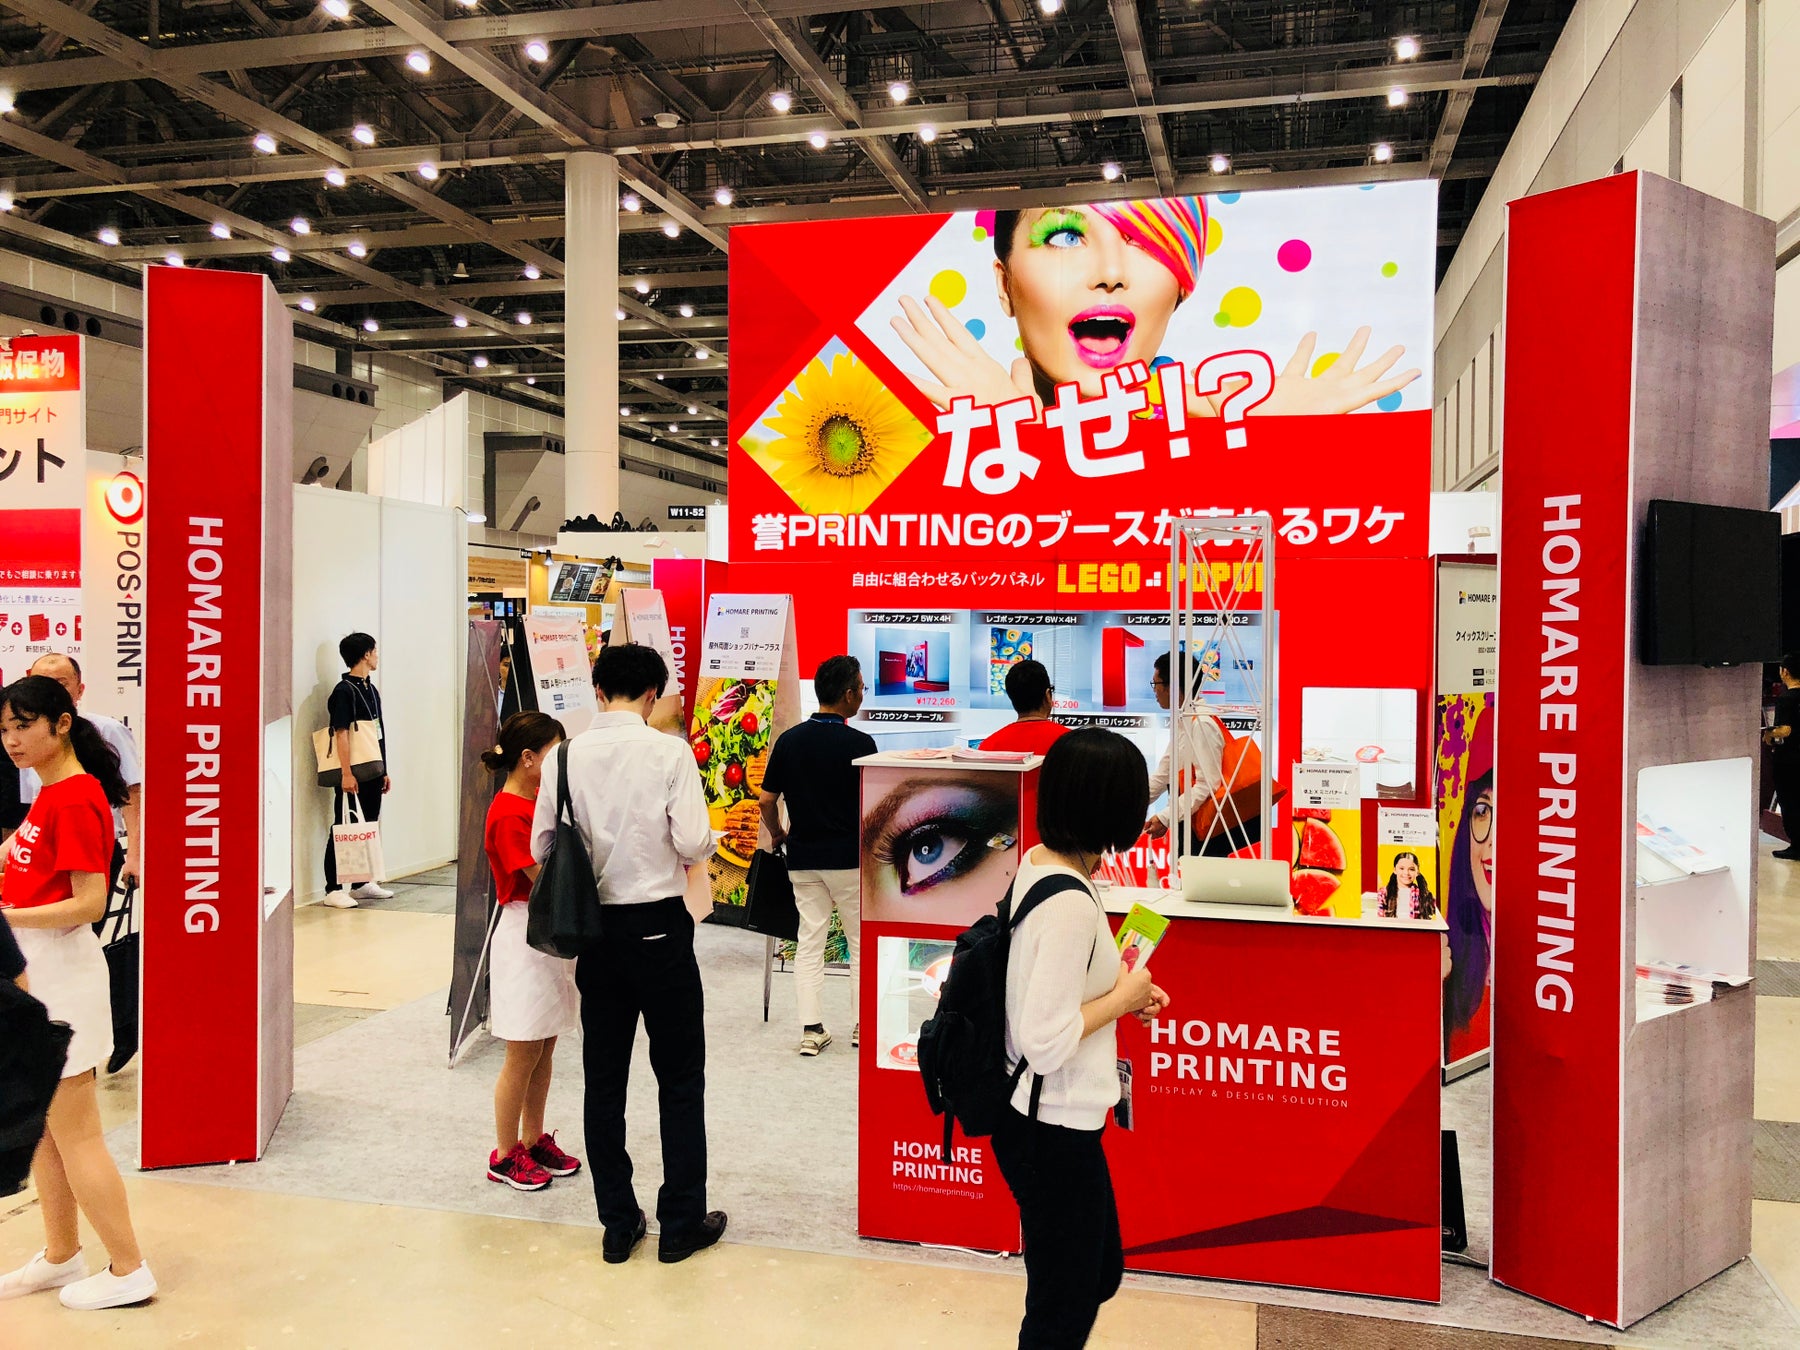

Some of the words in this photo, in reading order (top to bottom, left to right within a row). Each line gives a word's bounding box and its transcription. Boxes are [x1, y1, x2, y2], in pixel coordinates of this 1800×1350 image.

[935, 350, 1275, 495] なぜ!?
[670, 508, 704, 517] W11-52
[852, 571, 1045, 587] 自由に組合わせるバックパネル
[1057, 563, 1141, 593] LEGO
[1166, 562, 1275, 592] POPU
[186, 516, 223, 707] HOMARE
[1467, 594, 1490, 603] HOMARE
[864, 614, 919, 623] レゴポップアップ
[986, 615, 1044, 624] レゴポップアップ
[1538, 494, 1581, 732] HOMARE
[117, 602, 142, 687] PRINT
[184, 724, 221, 934] PRINTING
[335, 831, 376, 842] EUROPORT
[1534, 752, 1577, 1013] PRINTING
[1151, 1018, 1341, 1056] HOMARE
[1151, 1051, 1348, 1092] PRINTING
[1150, 1085, 1203, 1096] DISPLAY
[1211, 1089, 1218, 1097] &
[1226, 1091, 1274, 1102] DESIGN
[1282, 1095, 1348, 1108] SOLUTION
[892, 1161, 983, 1185] PRINTING
[892, 1181, 984, 1200] https://homareprinting.jp
